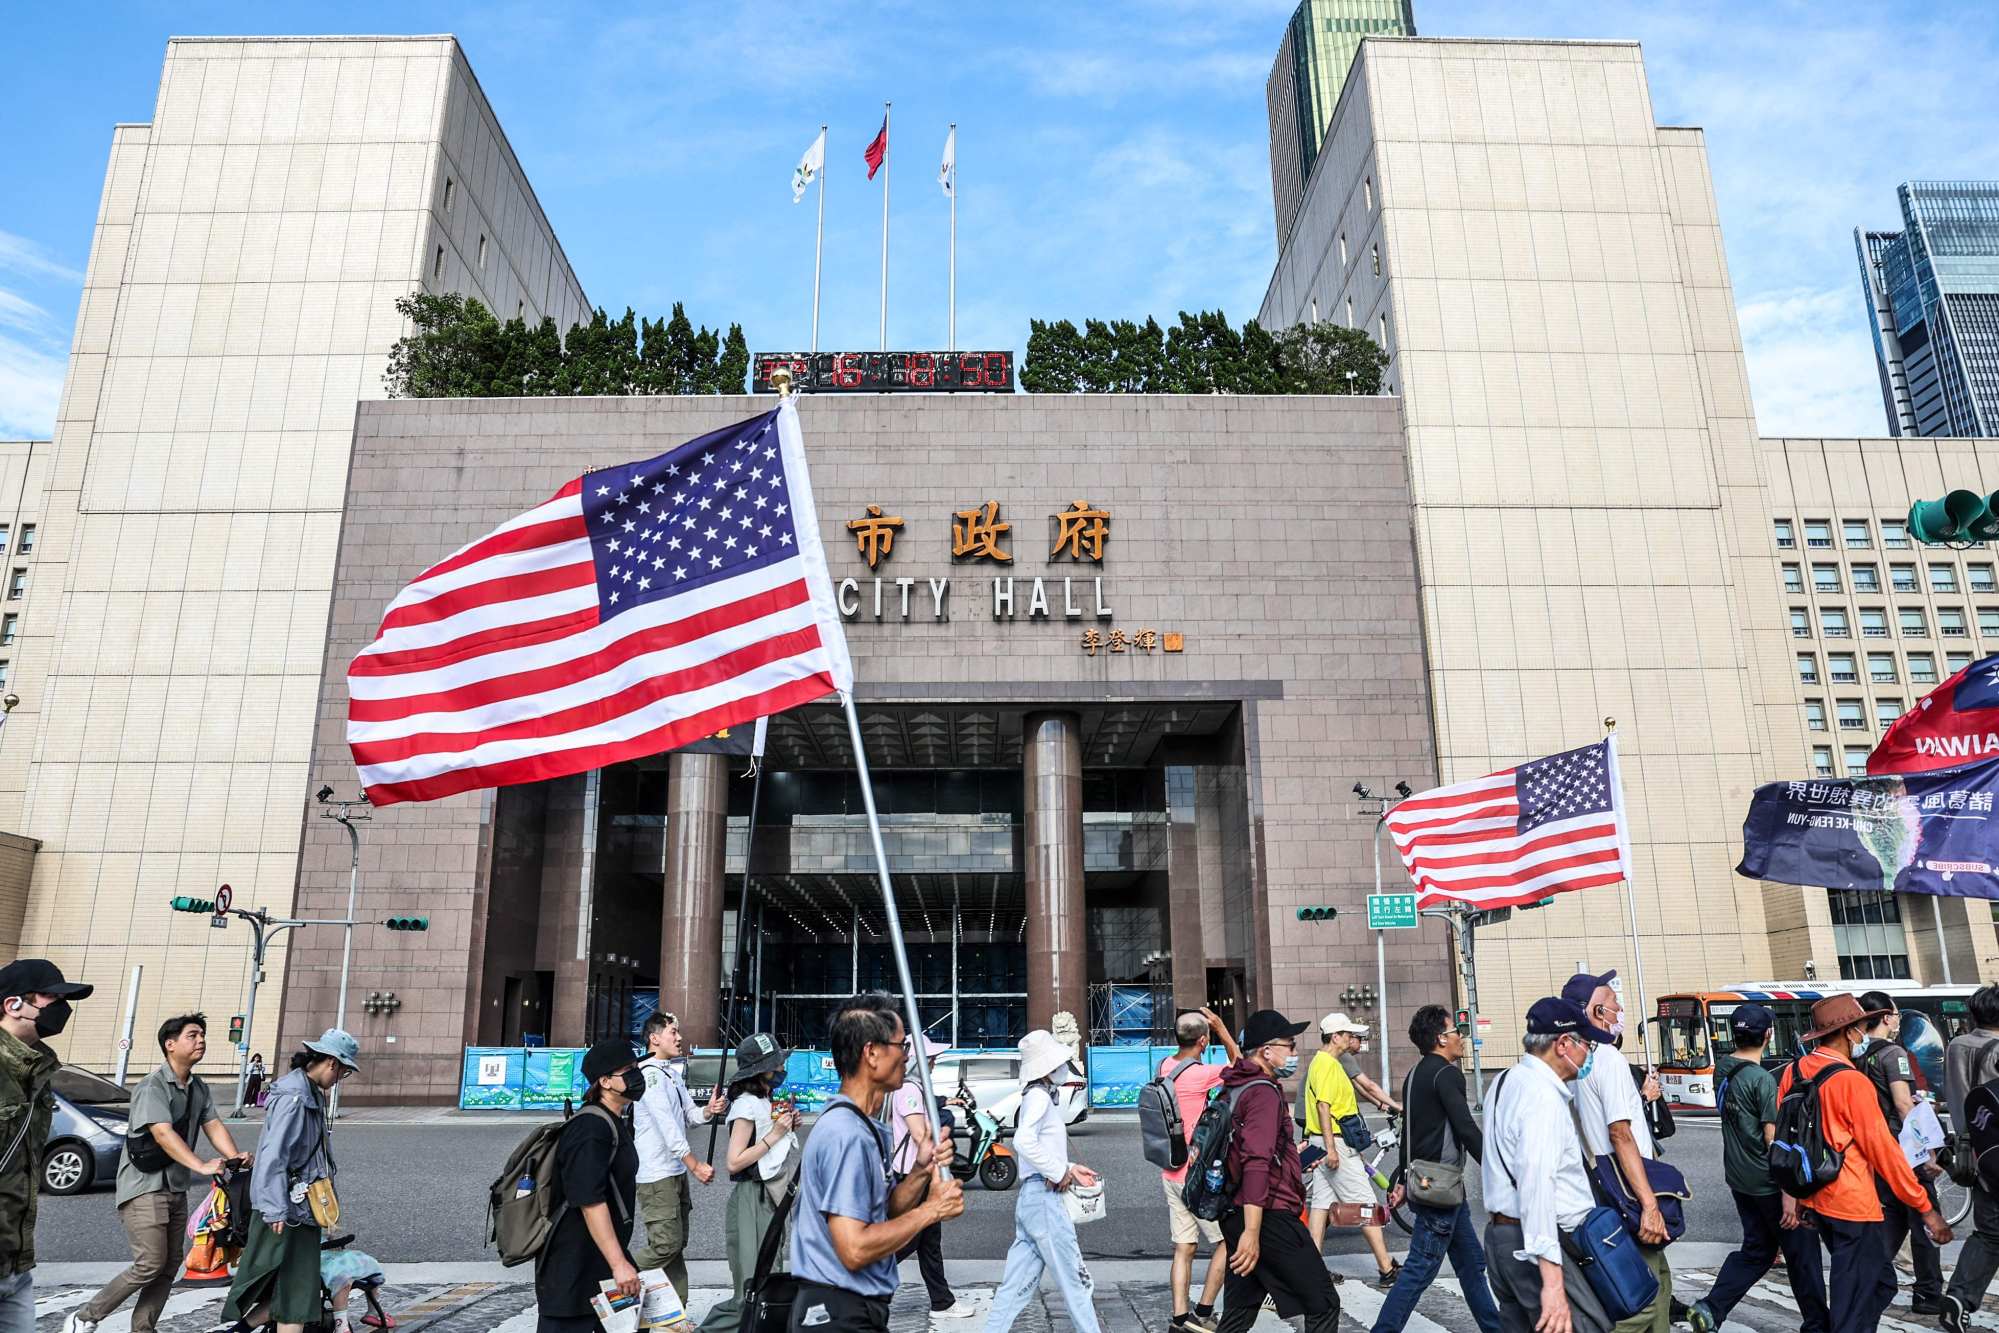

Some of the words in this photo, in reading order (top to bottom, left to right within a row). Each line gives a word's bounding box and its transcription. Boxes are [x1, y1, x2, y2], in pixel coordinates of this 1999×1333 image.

[847, 500, 1111, 569] 市政府
[838, 577, 949, 618] CITY
[994, 576, 1113, 617] HALL
